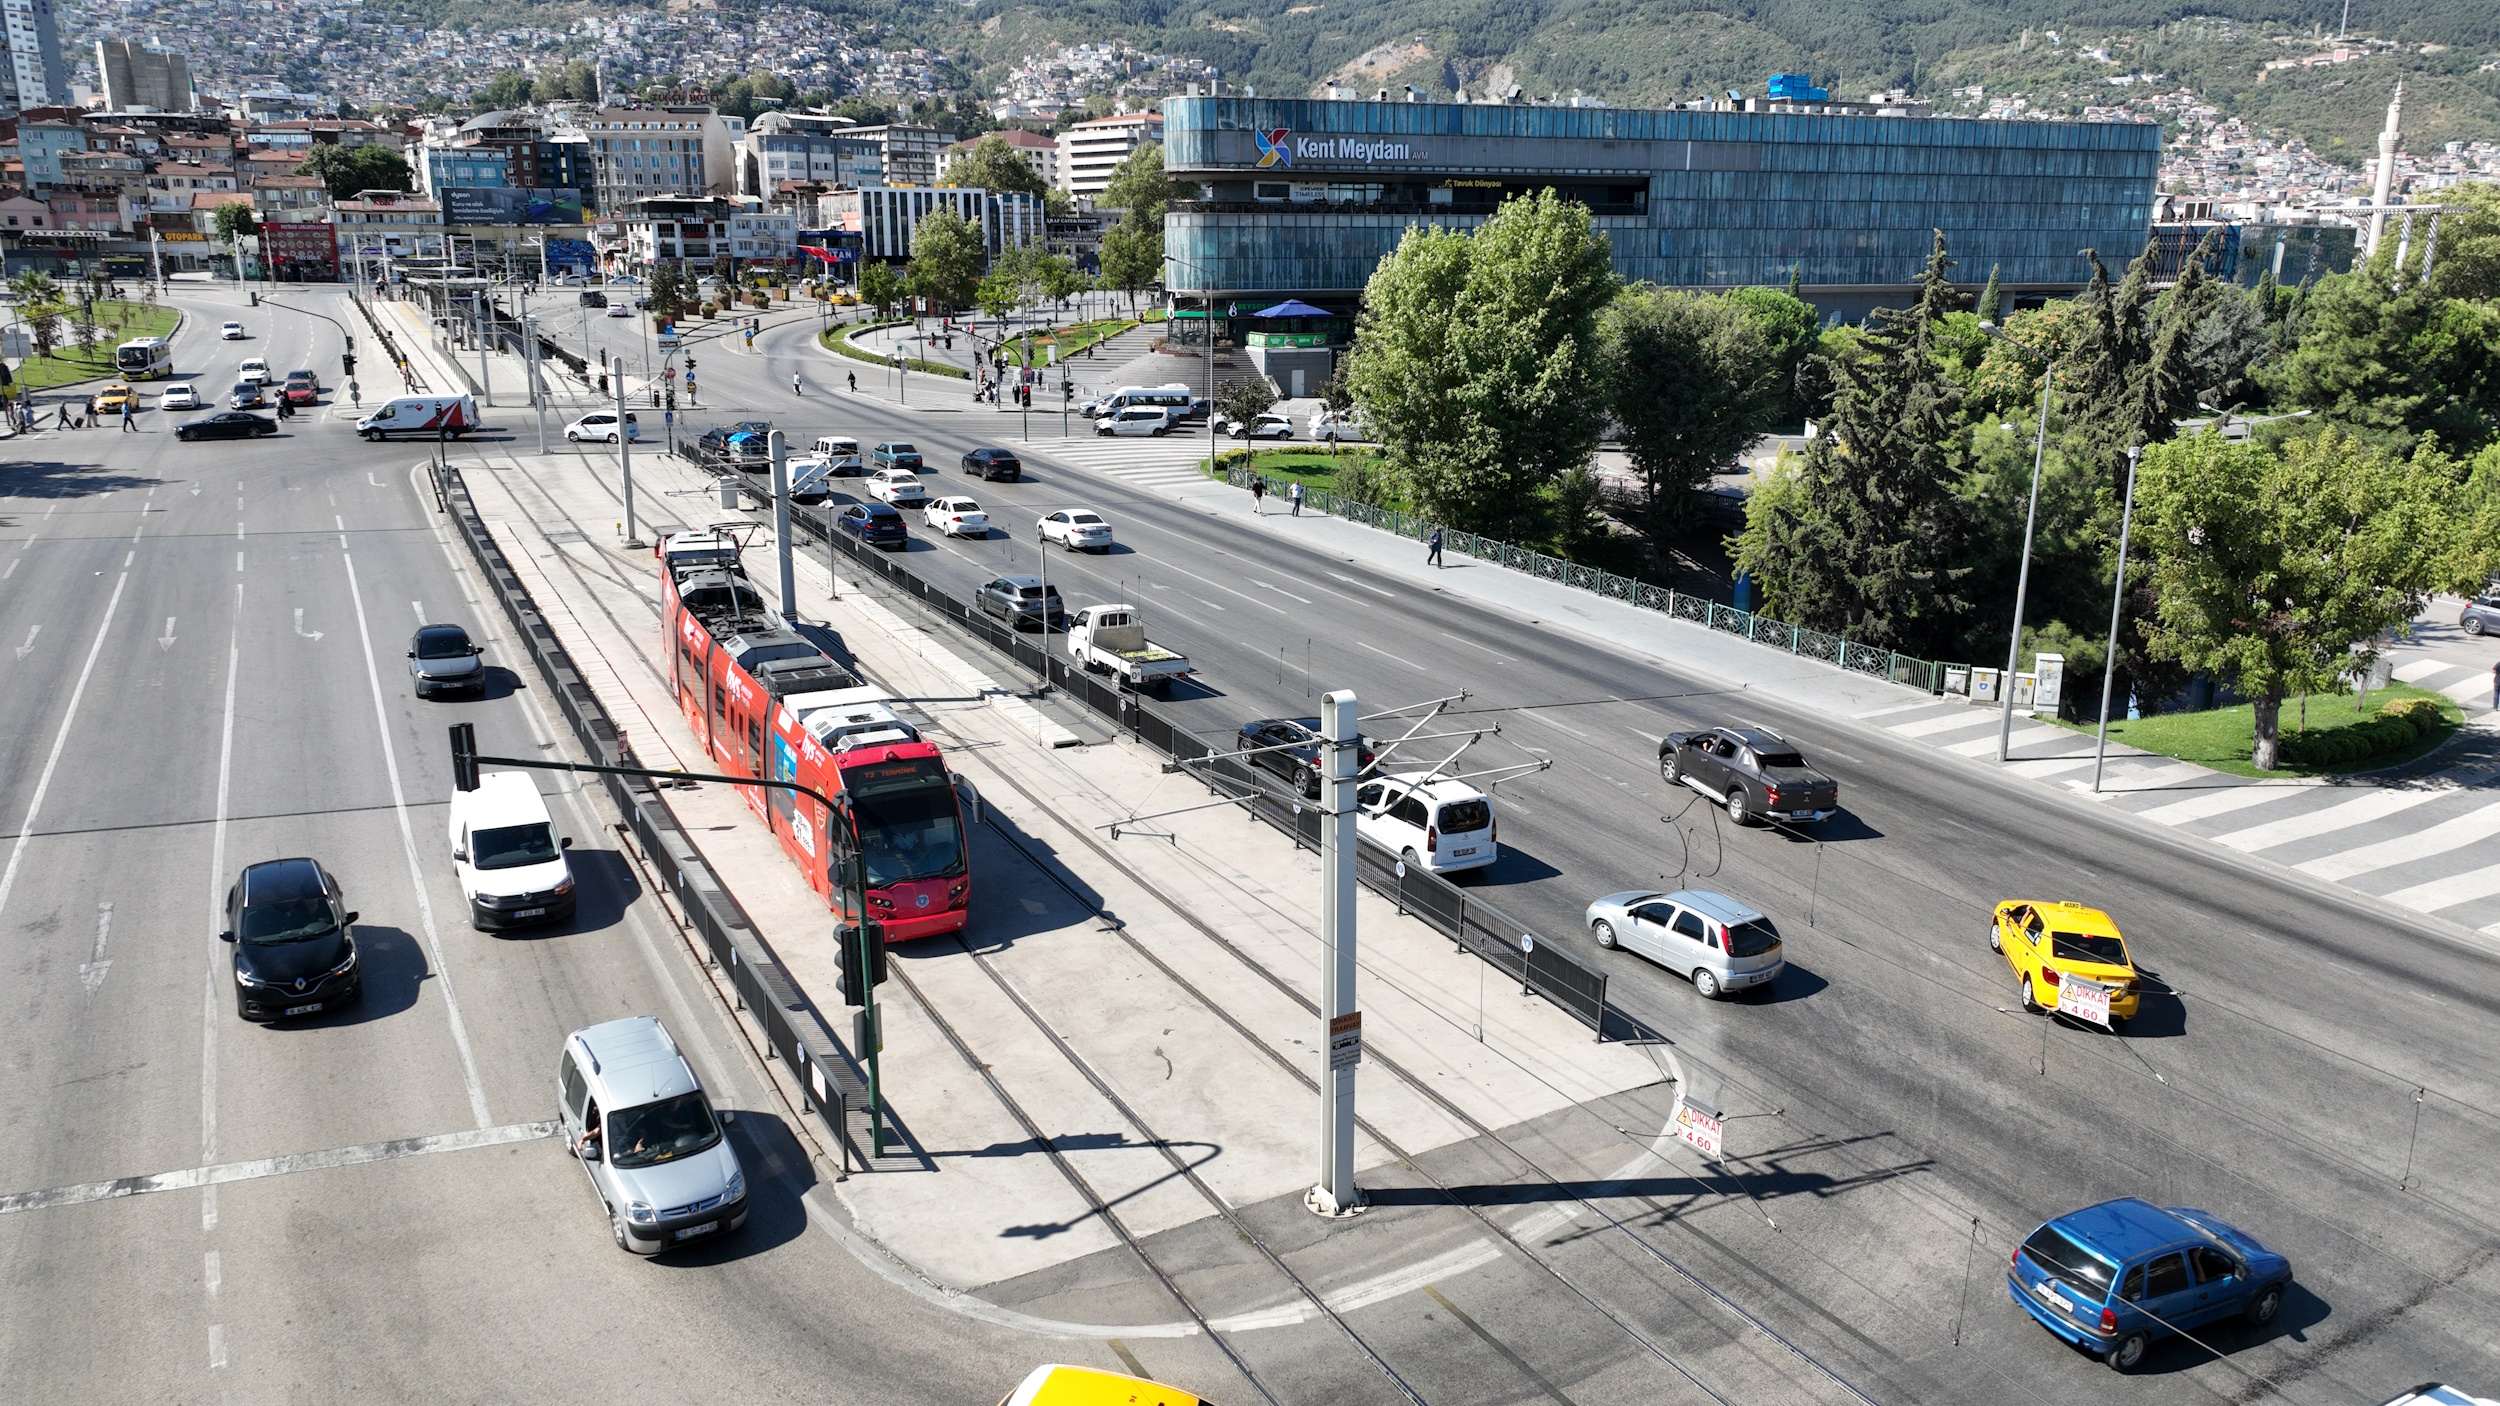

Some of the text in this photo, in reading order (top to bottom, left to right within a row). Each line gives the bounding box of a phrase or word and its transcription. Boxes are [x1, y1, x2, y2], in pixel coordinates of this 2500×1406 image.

[1297, 137, 1429, 164] Kent Meydanı AVM
[1453, 180, 1474, 188] Tavuk
[451, 191, 471, 200] dyson
[683, 216, 705, 224] TERAS
[27, 230, 105, 238] OTOPARK
[165, 232, 204, 241] OTOPARK
[801, 730, 817, 761] hys
[864, 771, 876, 779] T2
[2071, 1005, 2098, 1021] 4.60
[1331, 1022, 1360, 1034] TRAMVAY
[1686, 1132, 1711, 1151] 4.60
